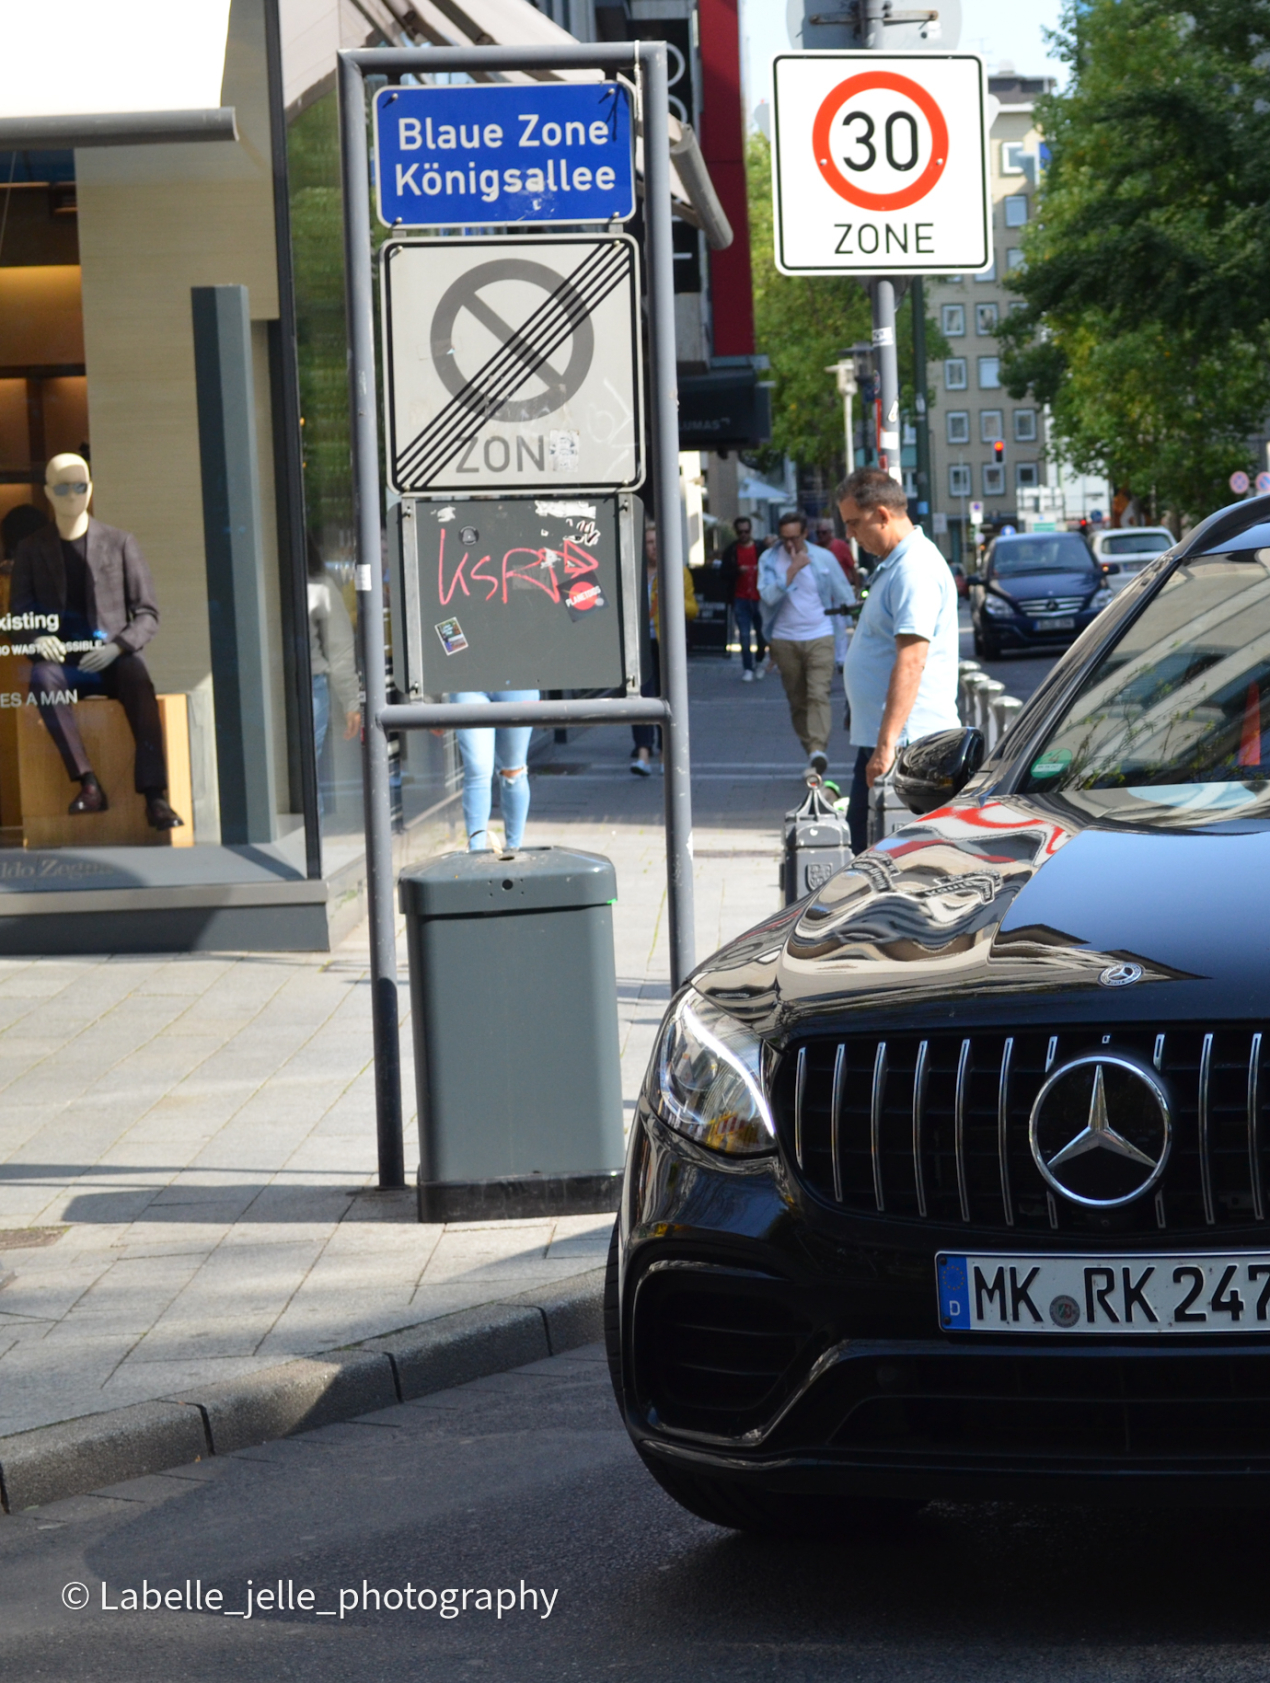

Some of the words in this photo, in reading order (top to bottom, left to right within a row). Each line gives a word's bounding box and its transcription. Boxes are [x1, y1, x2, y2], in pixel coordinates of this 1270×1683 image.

[399, 117, 503, 150] Blaue
[518, 114, 609, 147] Zone
[842, 110, 918, 171] 30
[395, 159, 616, 202] Königsallee
[834, 223, 934, 254] ZONE
[455, 434, 546, 473] ZON
[12, 644, 45, 655] WAST
[26, 692, 38, 707] A
[41, 689, 78, 706] MAN
[949, 1301, 960, 1316] D
[973, 1266, 1044, 1322] MK
[1083, 1266, 1160, 1323] RK
